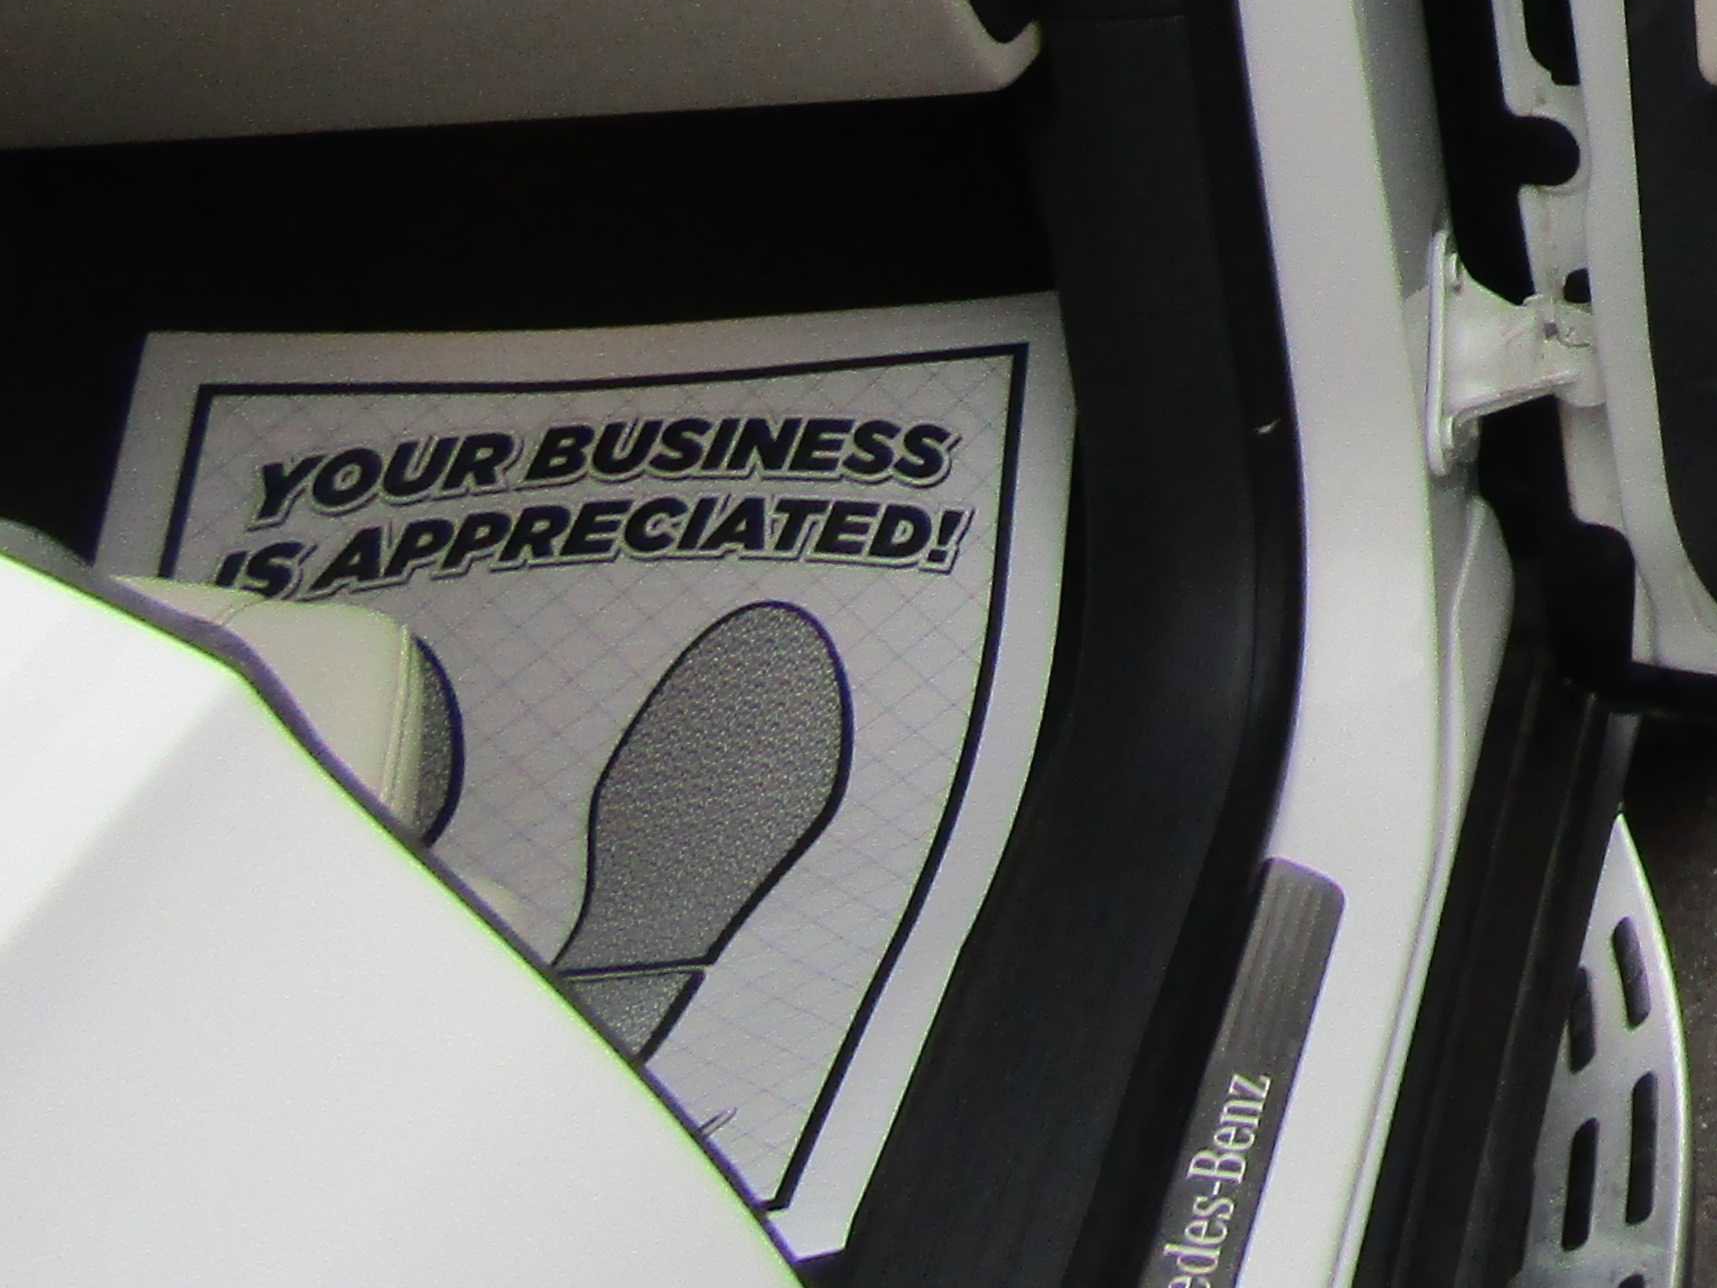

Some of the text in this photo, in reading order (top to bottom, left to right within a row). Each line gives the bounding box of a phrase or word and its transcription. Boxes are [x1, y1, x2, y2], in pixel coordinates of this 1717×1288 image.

[252, 416, 959, 528] YOUR BUSINESS
[306, 495, 972, 597] APPRECIATED!
